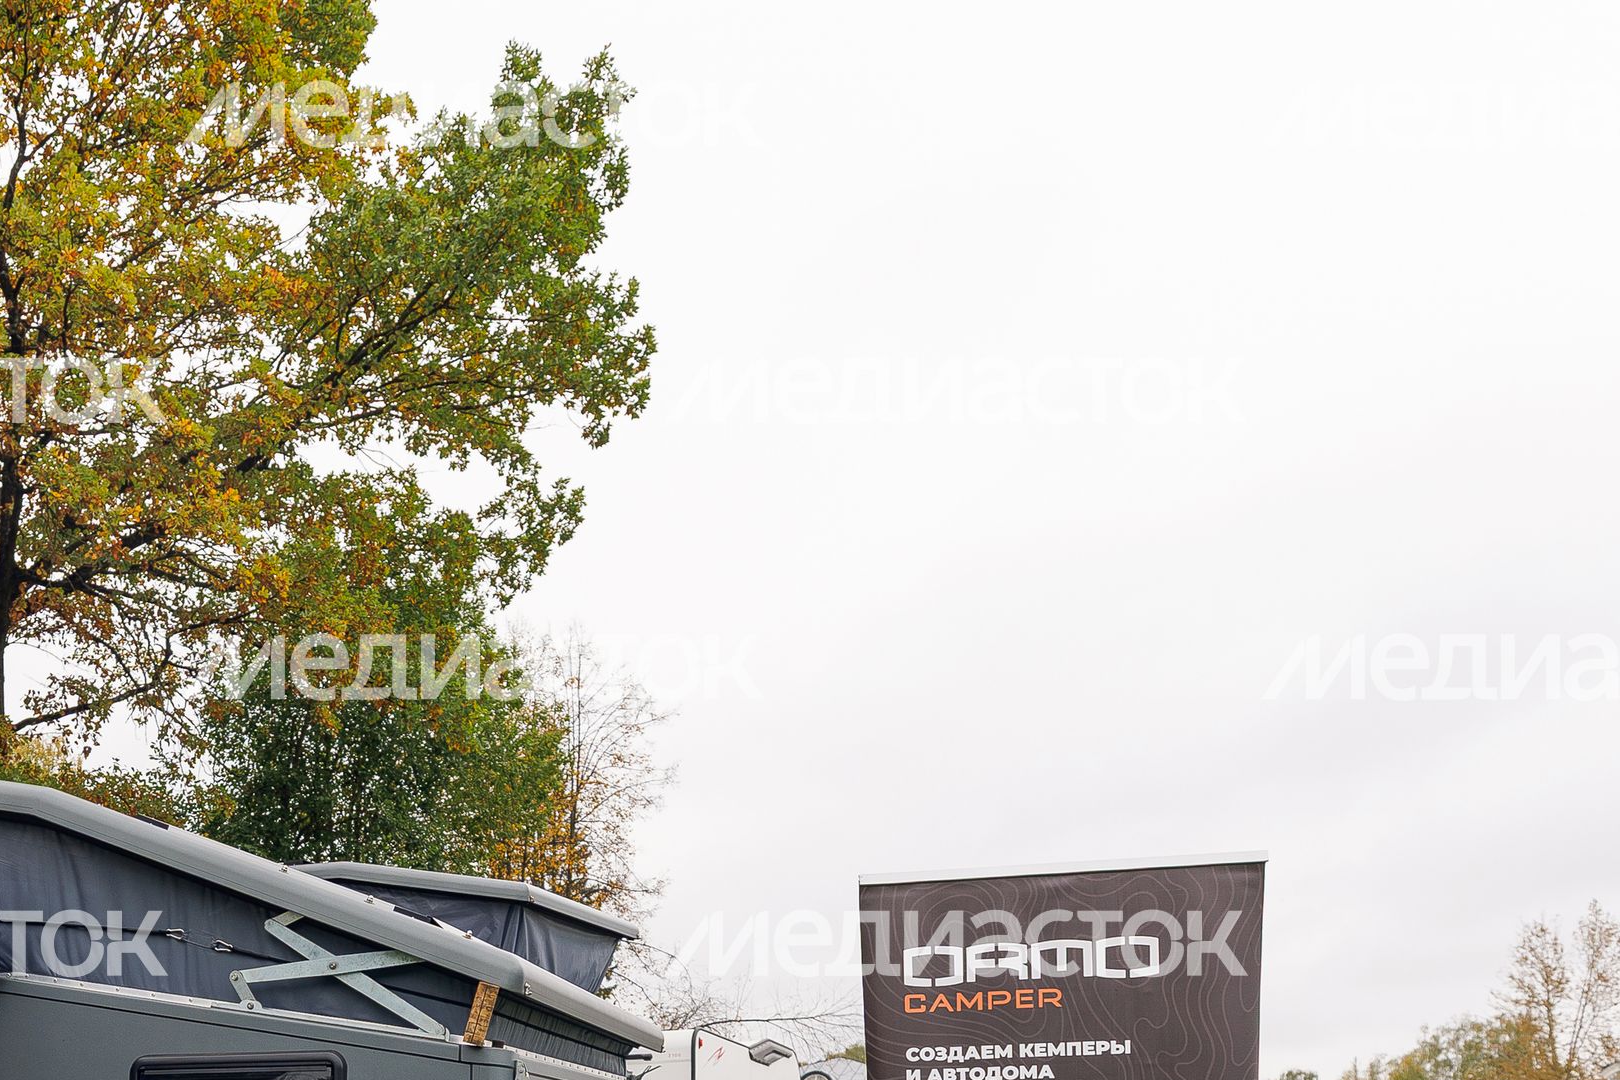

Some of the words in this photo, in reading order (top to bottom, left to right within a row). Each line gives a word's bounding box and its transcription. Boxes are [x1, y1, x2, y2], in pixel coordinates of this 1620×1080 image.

[902, 935, 1160, 988] ORMO
[903, 987, 1063, 1014] CAMPER
[905, 1044, 1013, 1063] СОЗДАЕМ
[1018, 1039, 1132, 1058] КЕМПЕРЫ
